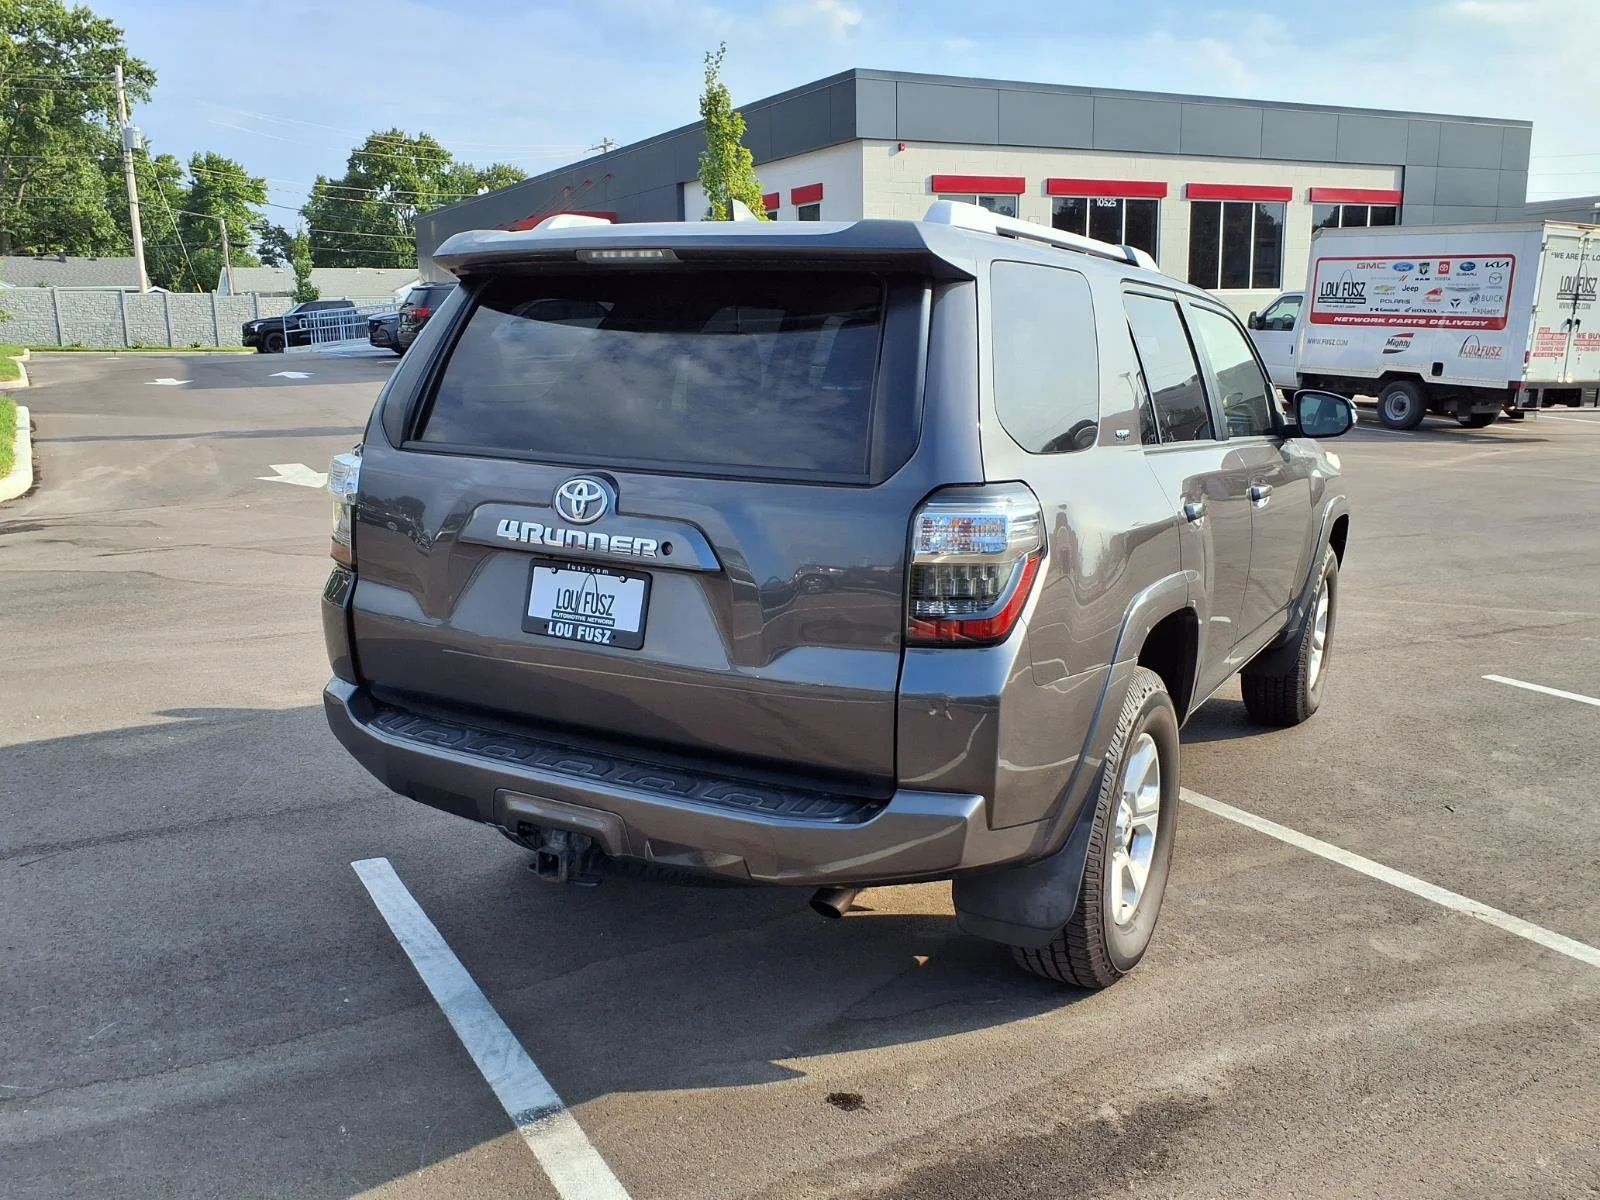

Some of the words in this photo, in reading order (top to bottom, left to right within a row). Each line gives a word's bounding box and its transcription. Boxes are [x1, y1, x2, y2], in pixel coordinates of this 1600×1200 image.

[1096, 198, 1117, 207] 10525
[1356, 262, 1387, 270] GMC
[1320, 281, 1339, 297] LOU
[1341, 281, 1366, 297] FUSZ
[1402, 284, 1419, 293] Jeep
[1560, 275, 1577, 293] LOU
[1481, 294, 1504, 303] BUICK
[1333, 316, 1386, 324] NETWORK
[1429, 319, 1489, 327] DELIVERY
[1307, 337, 1349, 346] WWW.FUSZ.COM
[1385, 338, 1411, 348] Mighty
[1463, 344, 1478, 355] LOU
[1479, 345, 1503, 357] FUSZ
[496, 519, 659, 558] 4RUNNER
[567, 563, 609, 575] fusz.com
[556, 587, 580, 612] LOU
[583, 591, 616, 617] FUSZ
[552, 611, 586, 622] AUTOMOTIVE
[587, 616, 614, 626] NETWORK
[547, 621, 574, 638] LOU
[576, 625, 612, 644] FUSZ
